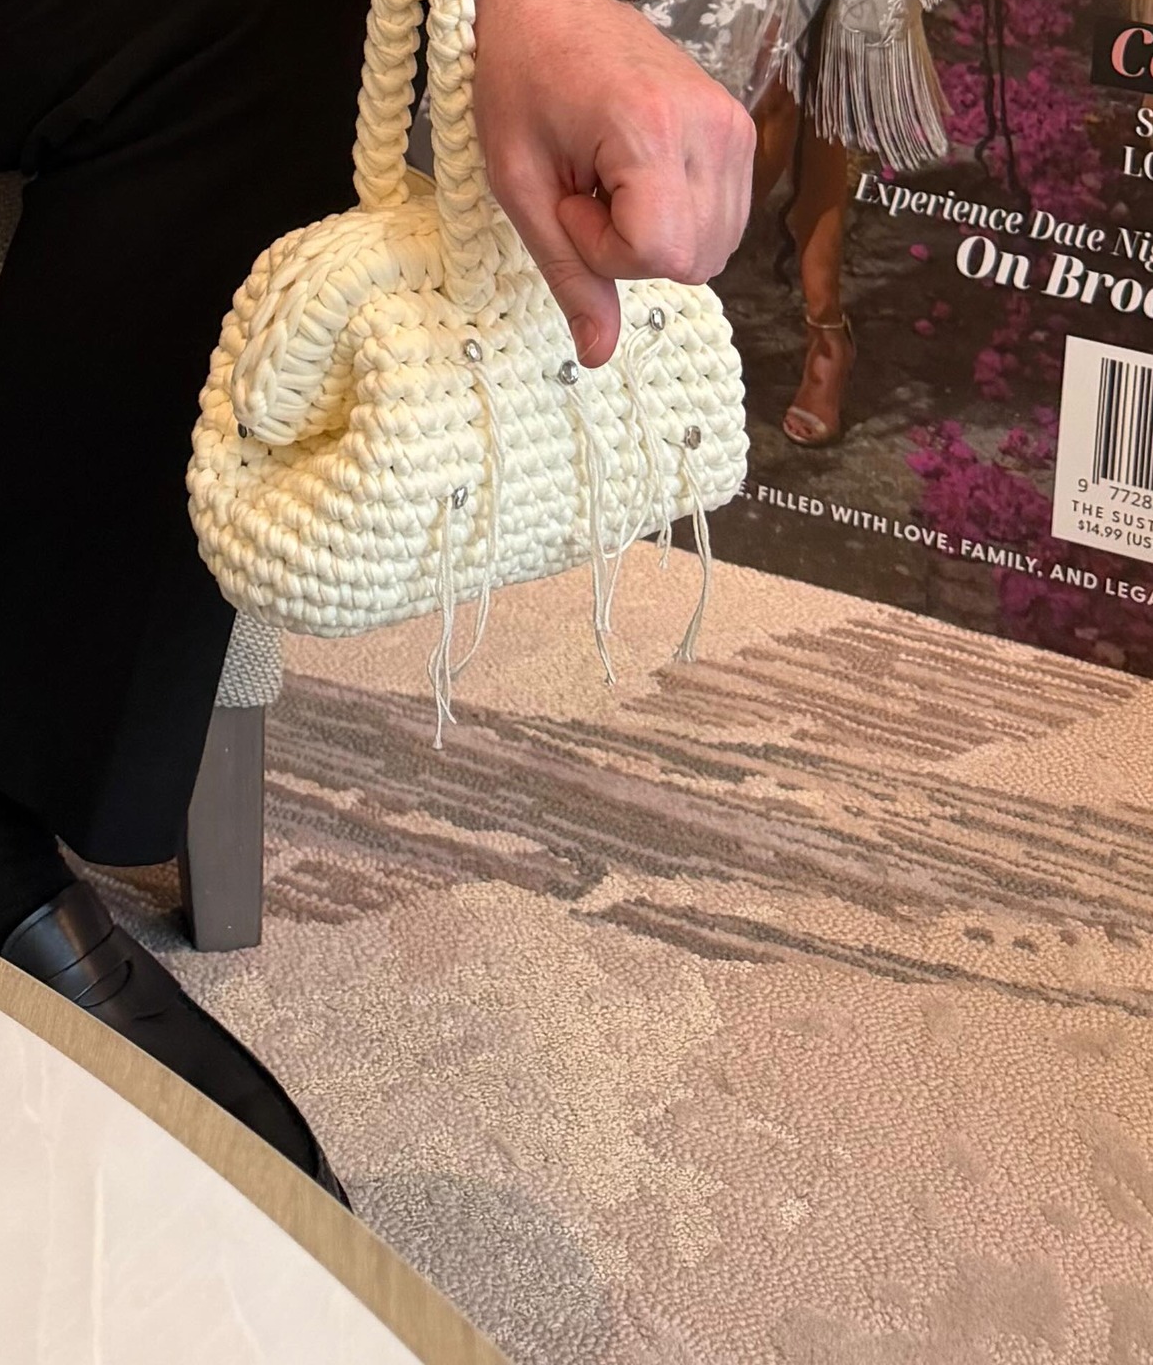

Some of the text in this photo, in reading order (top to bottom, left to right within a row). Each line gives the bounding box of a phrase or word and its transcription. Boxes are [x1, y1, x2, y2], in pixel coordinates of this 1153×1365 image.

[855, 172, 1023, 234] Experience
[1029, 209, 1105, 252] Date
[956, 235, 1030, 290] On
[1078, 478, 1088, 493] 9
[1072, 500, 1104, 519] THE
[758, 484, 824, 516] FILLED
[831, 504, 887, 534] WITH
[1050, 564, 1097, 590] AND
[1078, 520, 1122, 541] $14.99
